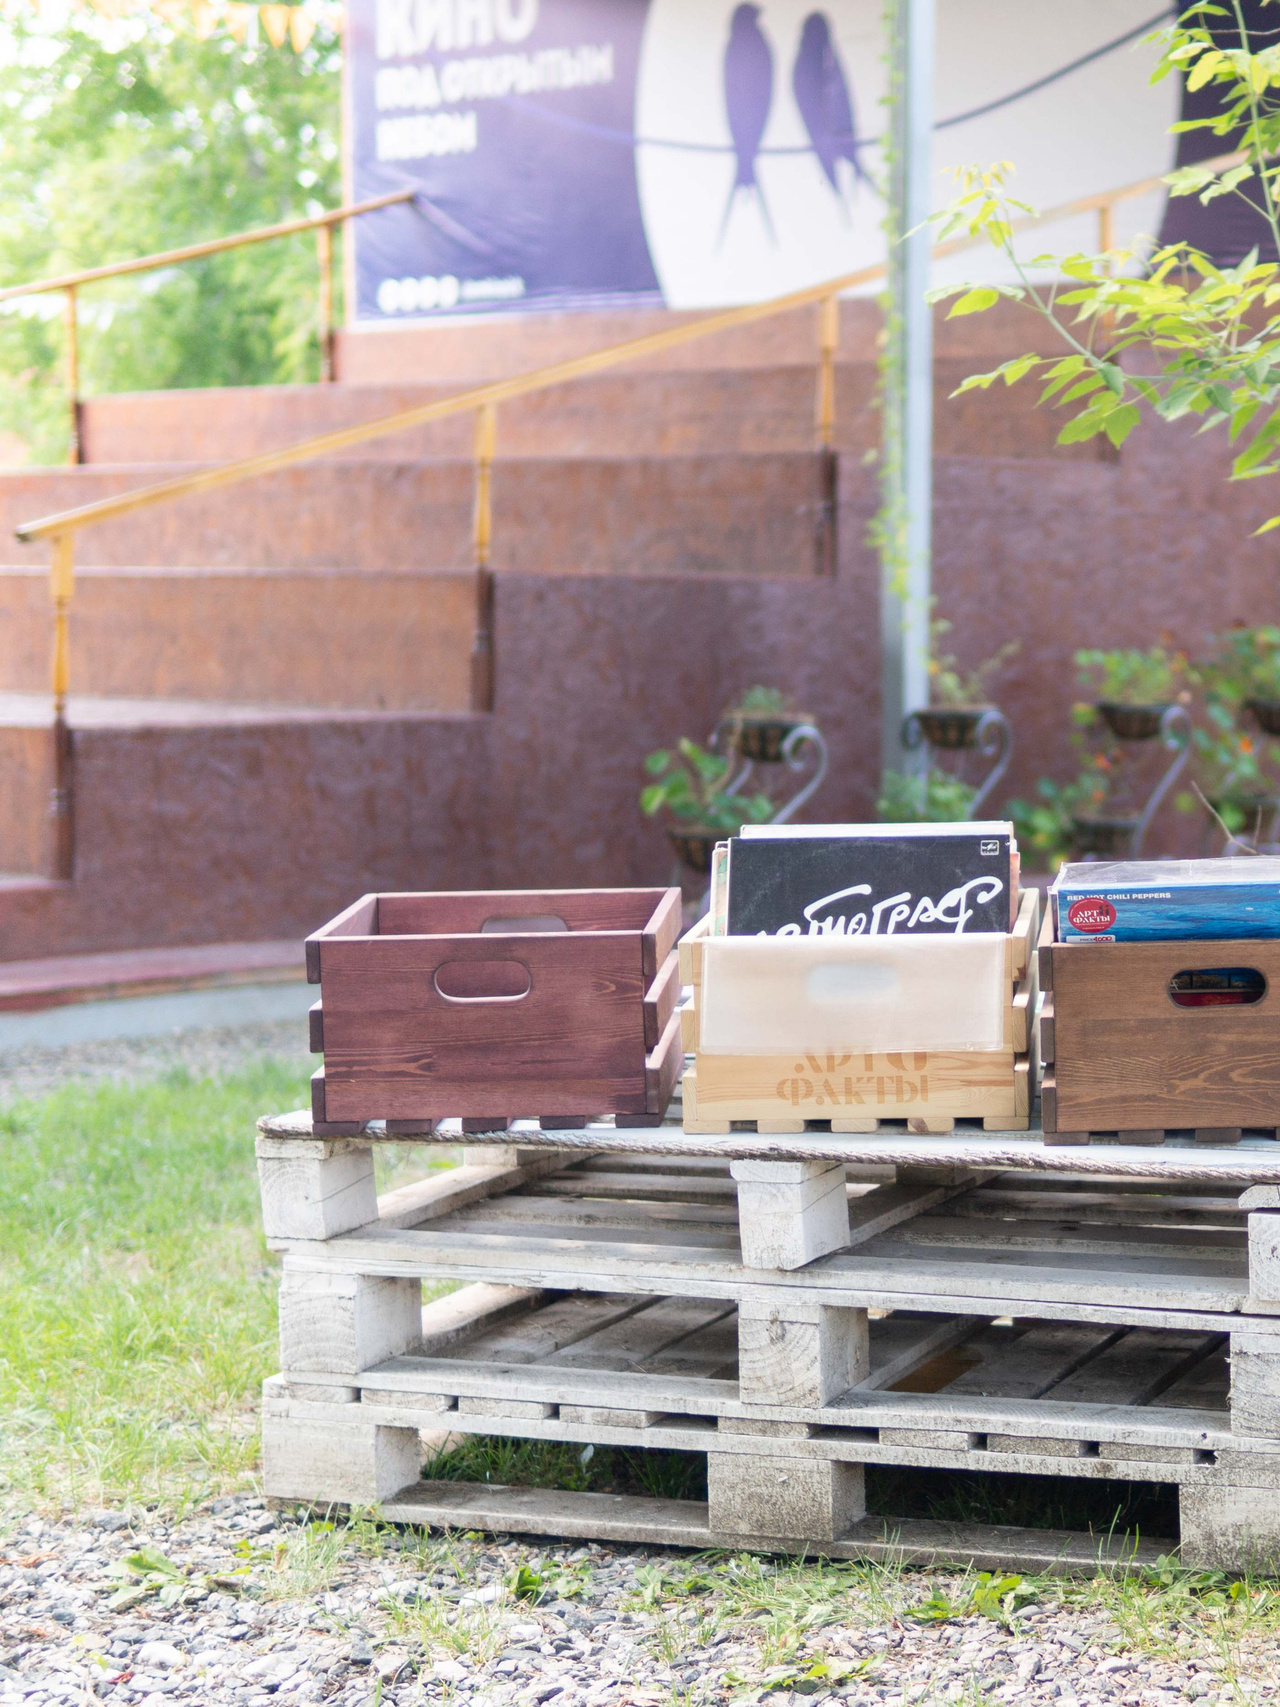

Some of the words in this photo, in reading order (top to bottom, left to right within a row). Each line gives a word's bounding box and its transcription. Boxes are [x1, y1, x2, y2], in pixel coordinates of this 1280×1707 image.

[375, 0, 538, 59] КИНО
[1132, 892, 1172, 900] PEPPERS
[1073, 915, 1111, 924] ФАКТЫ
[776, 1074, 929, 1106] ФАКТЫ
